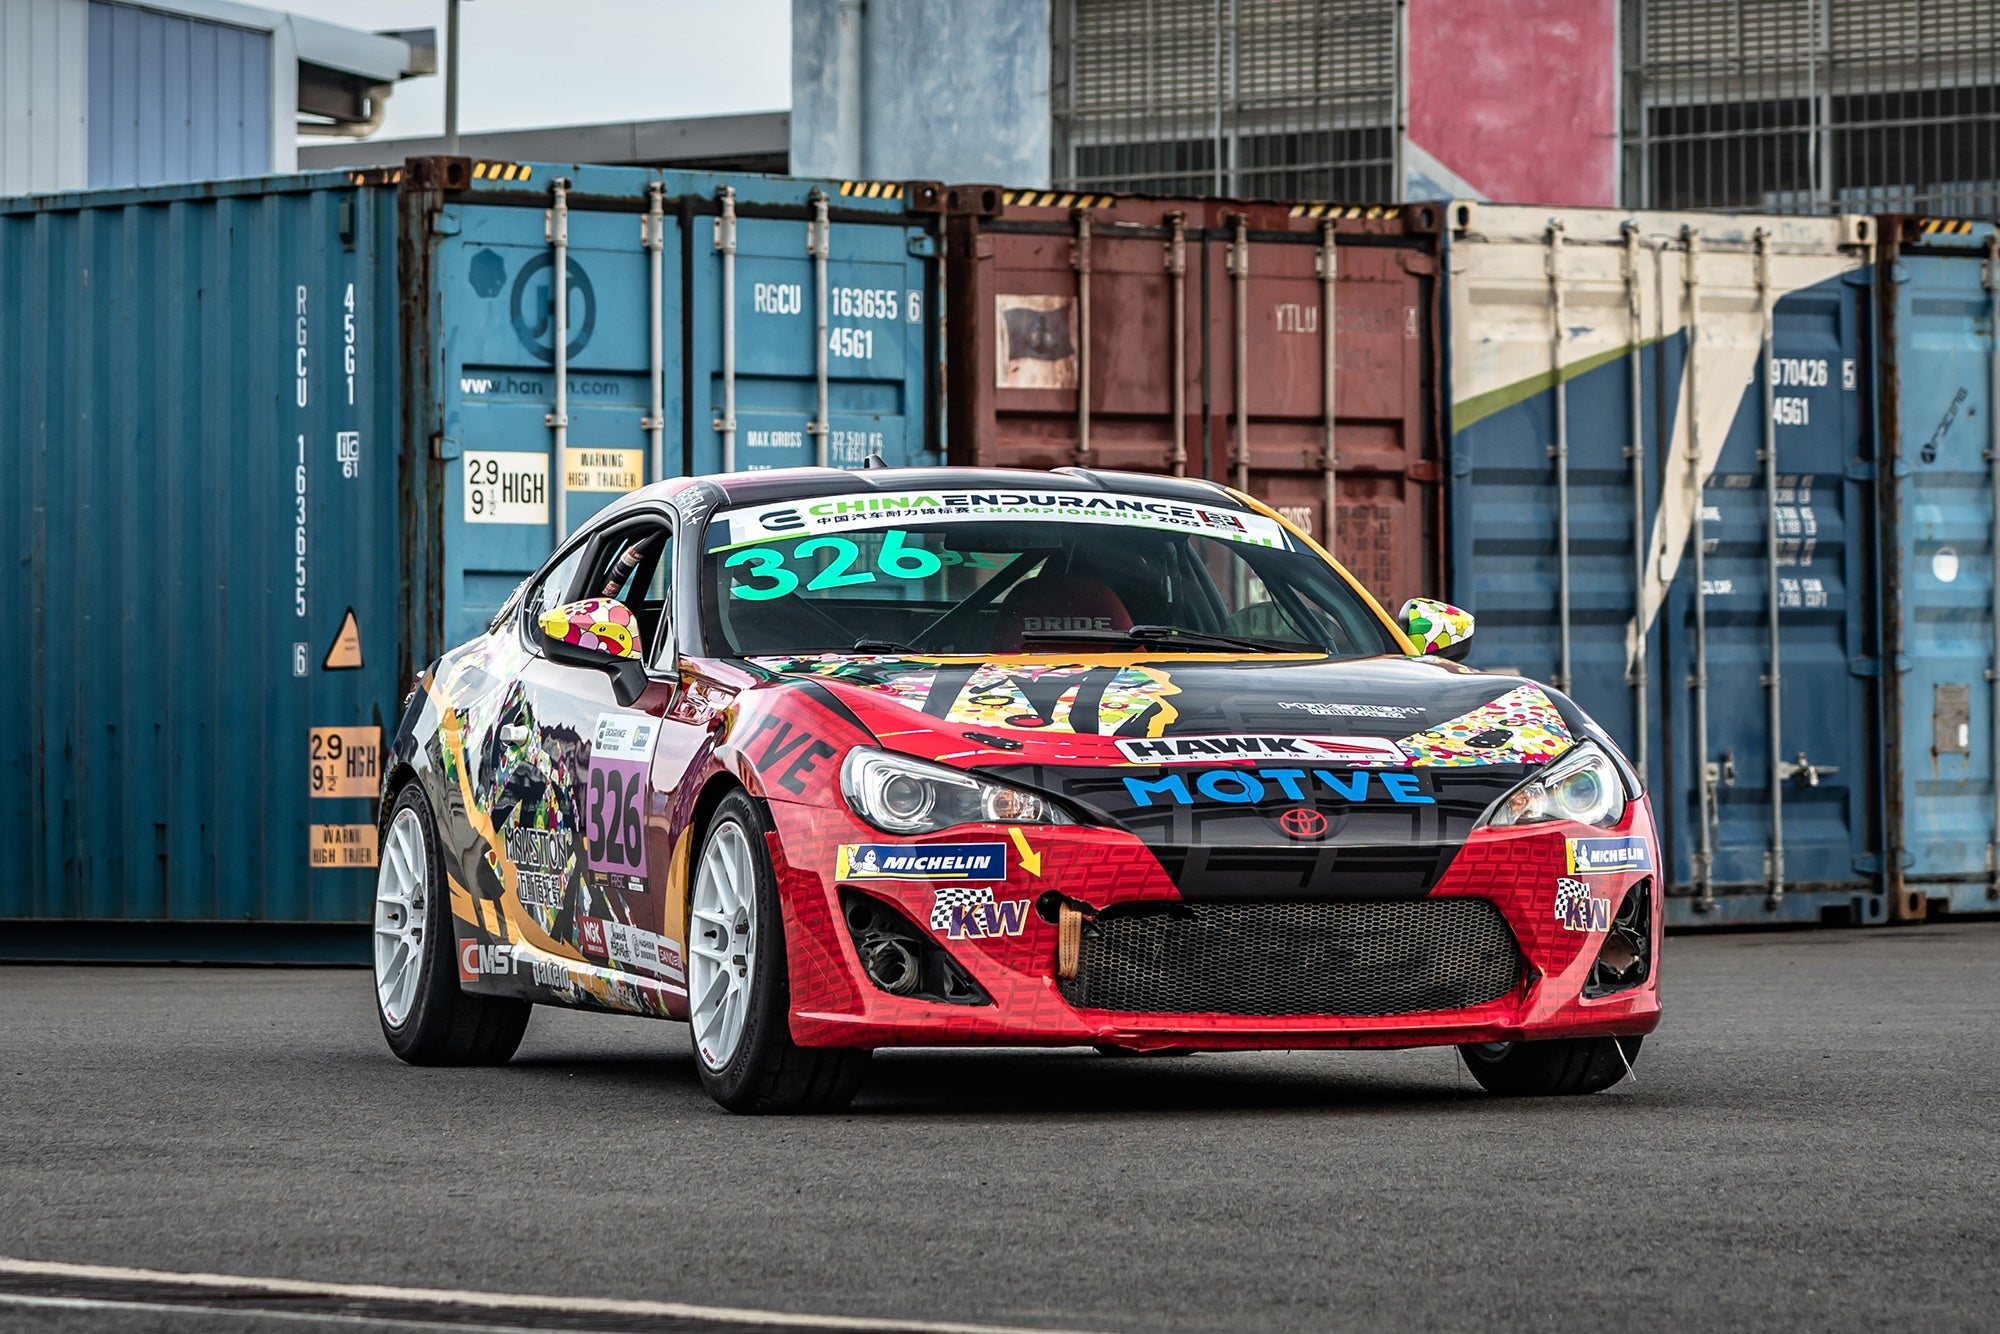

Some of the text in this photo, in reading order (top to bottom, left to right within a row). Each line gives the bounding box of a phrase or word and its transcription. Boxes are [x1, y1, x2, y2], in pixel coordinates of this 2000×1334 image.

[754, 283, 921, 322] RGCU 163655 6
[1275, 303, 1317, 333] YTLU
[296, 285, 308, 408] RGCU
[343, 283, 356, 405] 45G1
[829, 327, 873, 360] 45G1
[1771, 359, 1856, 389] 970426 5
[1773, 397, 1810, 426] 45G1
[469, 459, 499, 485] 2.9
[581, 453, 624, 468] WARNING
[502, 472, 544, 503] HIGH
[568, 473, 637, 488] HIGH TRAILER
[294, 434, 306, 617] 163655
[817, 506, 971, 525] 中国汽车耐力锦标赛
[973, 507, 1152, 520] CHAMPIONSHIP
[1158, 516, 1201, 528] 2023
[724, 529, 942, 601] 326
[1023, 616, 1112, 631] BRIDE
[312, 733, 342, 761] 2.9
[1126, 737, 1310, 757] HAWK
[1140, 752, 1400, 762] PERFORMANCE
[1122, 769, 1436, 807] MOTVE
[590, 767, 642, 868] 326
[883, 855, 991, 870] MICHELIN
[1590, 848, 1644, 863] MICHELIN
[947, 900, 1031, 939] KW
[1563, 897, 1611, 933] KW
[582, 920, 603, 944] NGK
[462, 944, 527, 976] CMST
[532, 957, 570, 989] pakelo
